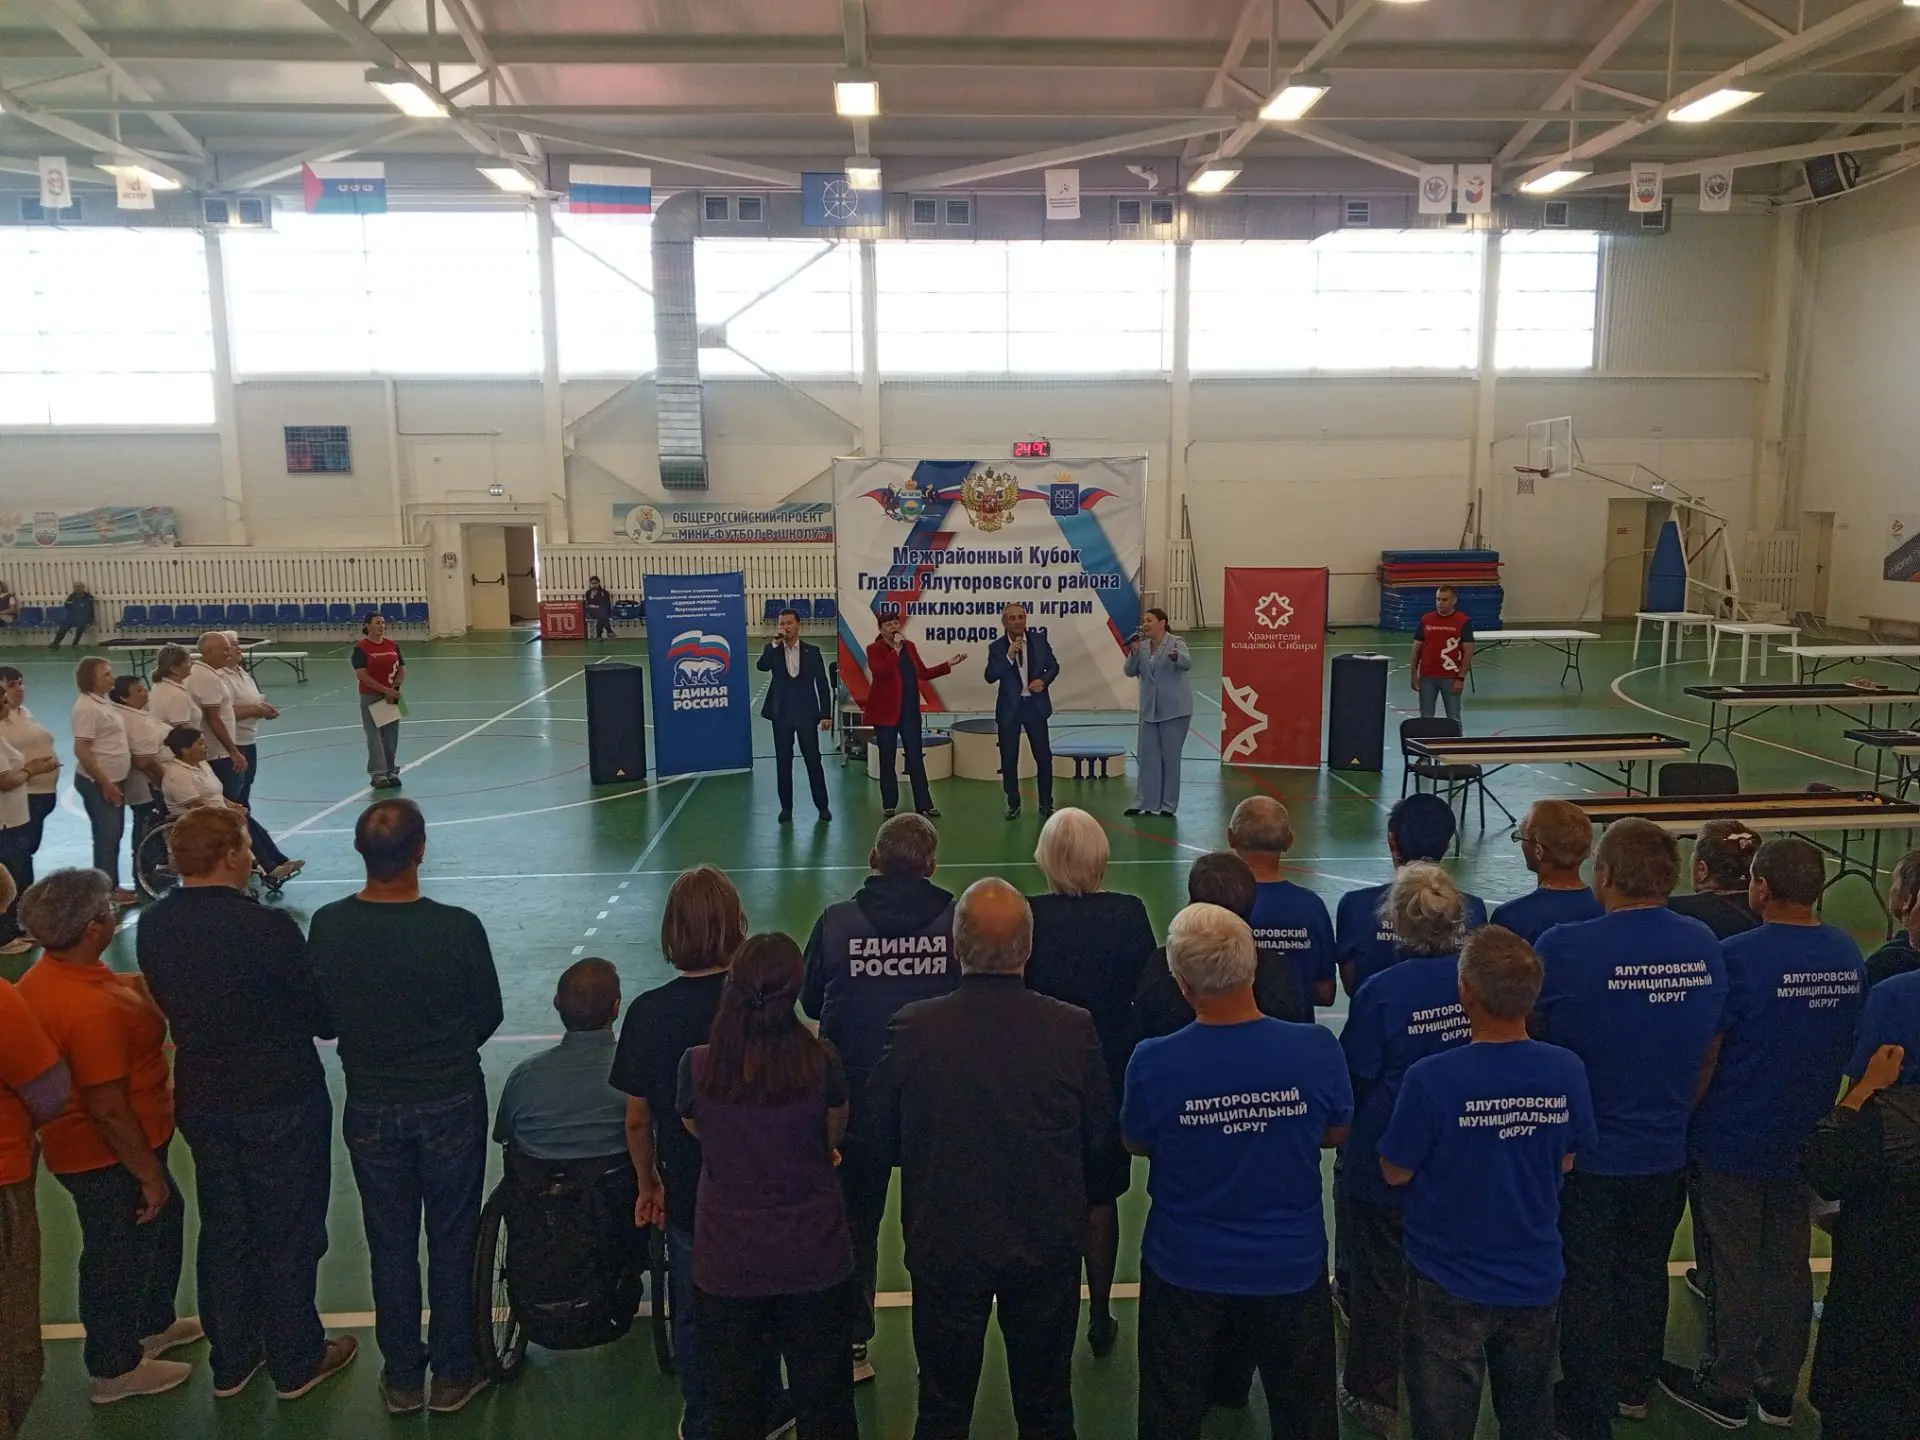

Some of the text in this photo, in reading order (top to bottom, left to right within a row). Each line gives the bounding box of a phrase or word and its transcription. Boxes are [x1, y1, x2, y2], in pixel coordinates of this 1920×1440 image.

[673, 511, 824, 523] ОБЩЕРОССИЙСКИЙ ПРОЕКТ
[893, 546, 1080, 568] Межрайонный Кубок
[858, 571, 1120, 594] Главы Ялуторовского района
[880, 601, 1092, 618] по инклюзивнм играм
[926, 627, 998, 644] народов
[1247, 631, 1301, 641] Хранители
[1278, 640, 1317, 652] Сибири
[672, 686, 728, 699] ЕДИНАЯ
[673, 697, 729, 710] РОССИЯ
[1252, 928, 1308, 937] ОРОВСКИЙ
[849, 936, 947, 956] ЕДИНАЯ
[1254, 939, 1312, 949] ИПАЛЬНЫЙ
[850, 956, 947, 976] РОССИЯ
[1615, 960, 1707, 976] ЯЛУТОРОВСКИЙ
[1608, 973, 1712, 990] МУНИЦИПАЛЬНЫЙ
[1648, 991, 1687, 1003] ОКРУГ
[1808, 998, 1839, 1008] ОКРУГ
[1412, 1003, 1465, 1021] ЯЛУТОРО
[1407, 1016, 1471, 1035] МУНИЦИПА
[1185, 1087, 1300, 1111] ЯЛУТОРОВСКИЙ
[1465, 1095, 1567, 1112] ЯЛУТОРОВСКИЙ
[1179, 1101, 1307, 1125] МУНИЦИПАЛЬНЫЙ
[1458, 1109, 1569, 1127] МУНИЦИПАЛЬНЫЙ
[1222, 1121, 1267, 1134] ОКРУГ
[1499, 1126, 1536, 1139] ОКРУГ
